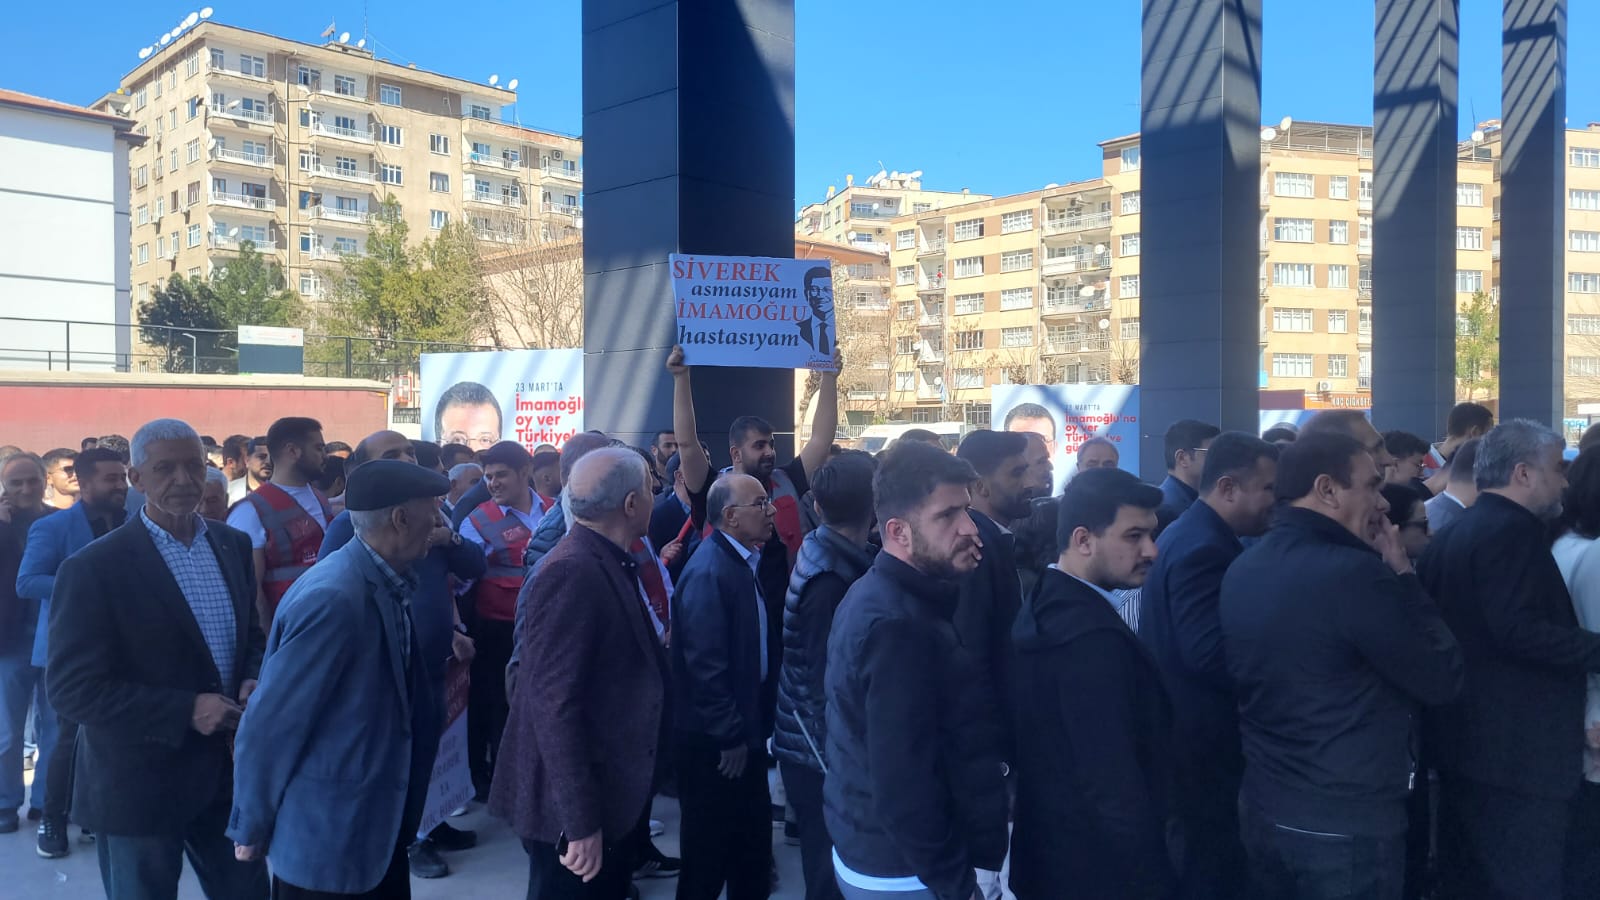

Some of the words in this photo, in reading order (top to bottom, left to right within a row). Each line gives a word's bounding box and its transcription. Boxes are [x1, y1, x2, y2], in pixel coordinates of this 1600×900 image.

[672, 257, 782, 282] SİVEREK
[691, 283, 798, 302] asmasıyam
[677, 298, 808, 322] İMAMOĞLU
[679, 325, 800, 351] hastasıyam
[515, 382, 525, 392] 23
[528, 381, 563, 392] MART'TA
[515, 393, 584, 414] İmamoğl
[515, 415, 533, 432] oy
[537, 415, 561, 425] ver
[1065, 411, 1137, 424] İmamoğlu'na
[515, 428, 576, 446] Türkiye'
[1065, 425, 1078, 435] oy
